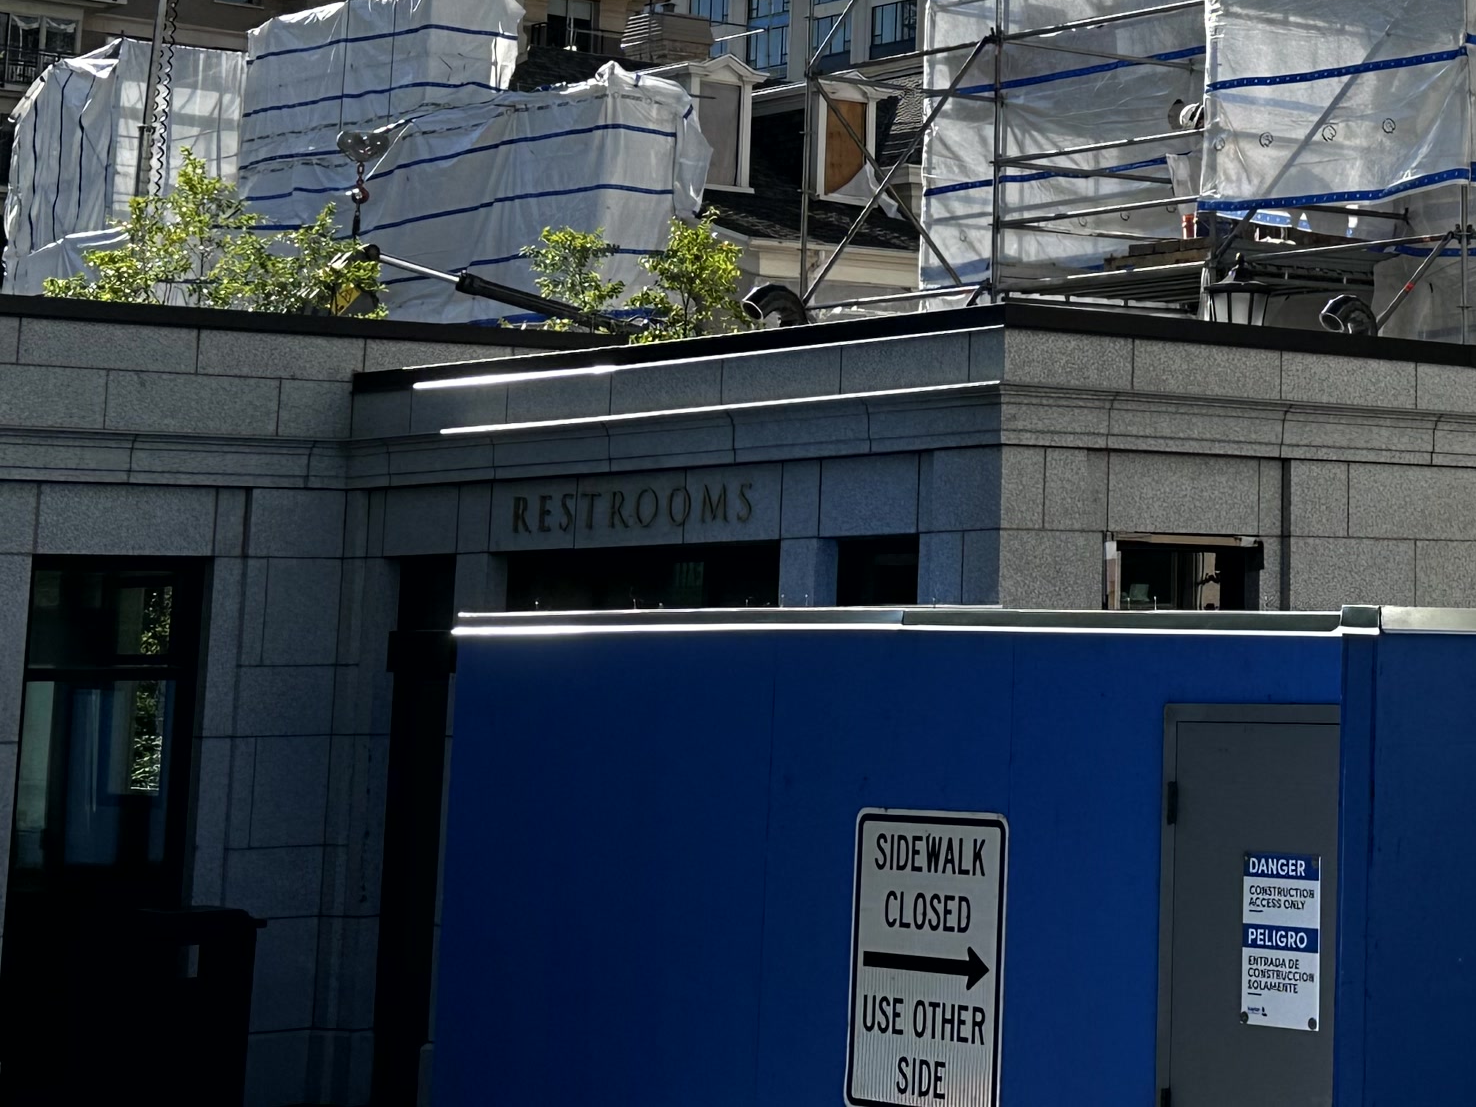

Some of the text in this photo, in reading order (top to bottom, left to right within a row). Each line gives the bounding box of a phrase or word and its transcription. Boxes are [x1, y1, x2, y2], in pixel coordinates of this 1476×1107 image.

[512, 482, 753, 534] RESTROOMS
[874, 832, 986, 877] SIDEWALK
[1249, 857, 1306, 877] DANGER
[1249, 885, 1315, 899] CONSTRUCTION
[884, 890, 971, 934] CLOSED
[1248, 897, 1306, 910] ACCESS ONLY
[1248, 928, 1308, 948] PELIGRO
[1248, 955, 1300, 970] ENTRADA DE
[1247, 979, 1299, 994] SOLAMENTE
[862, 994, 986, 1046] USE OTHER
[896, 1055, 947, 1100] SIDE
